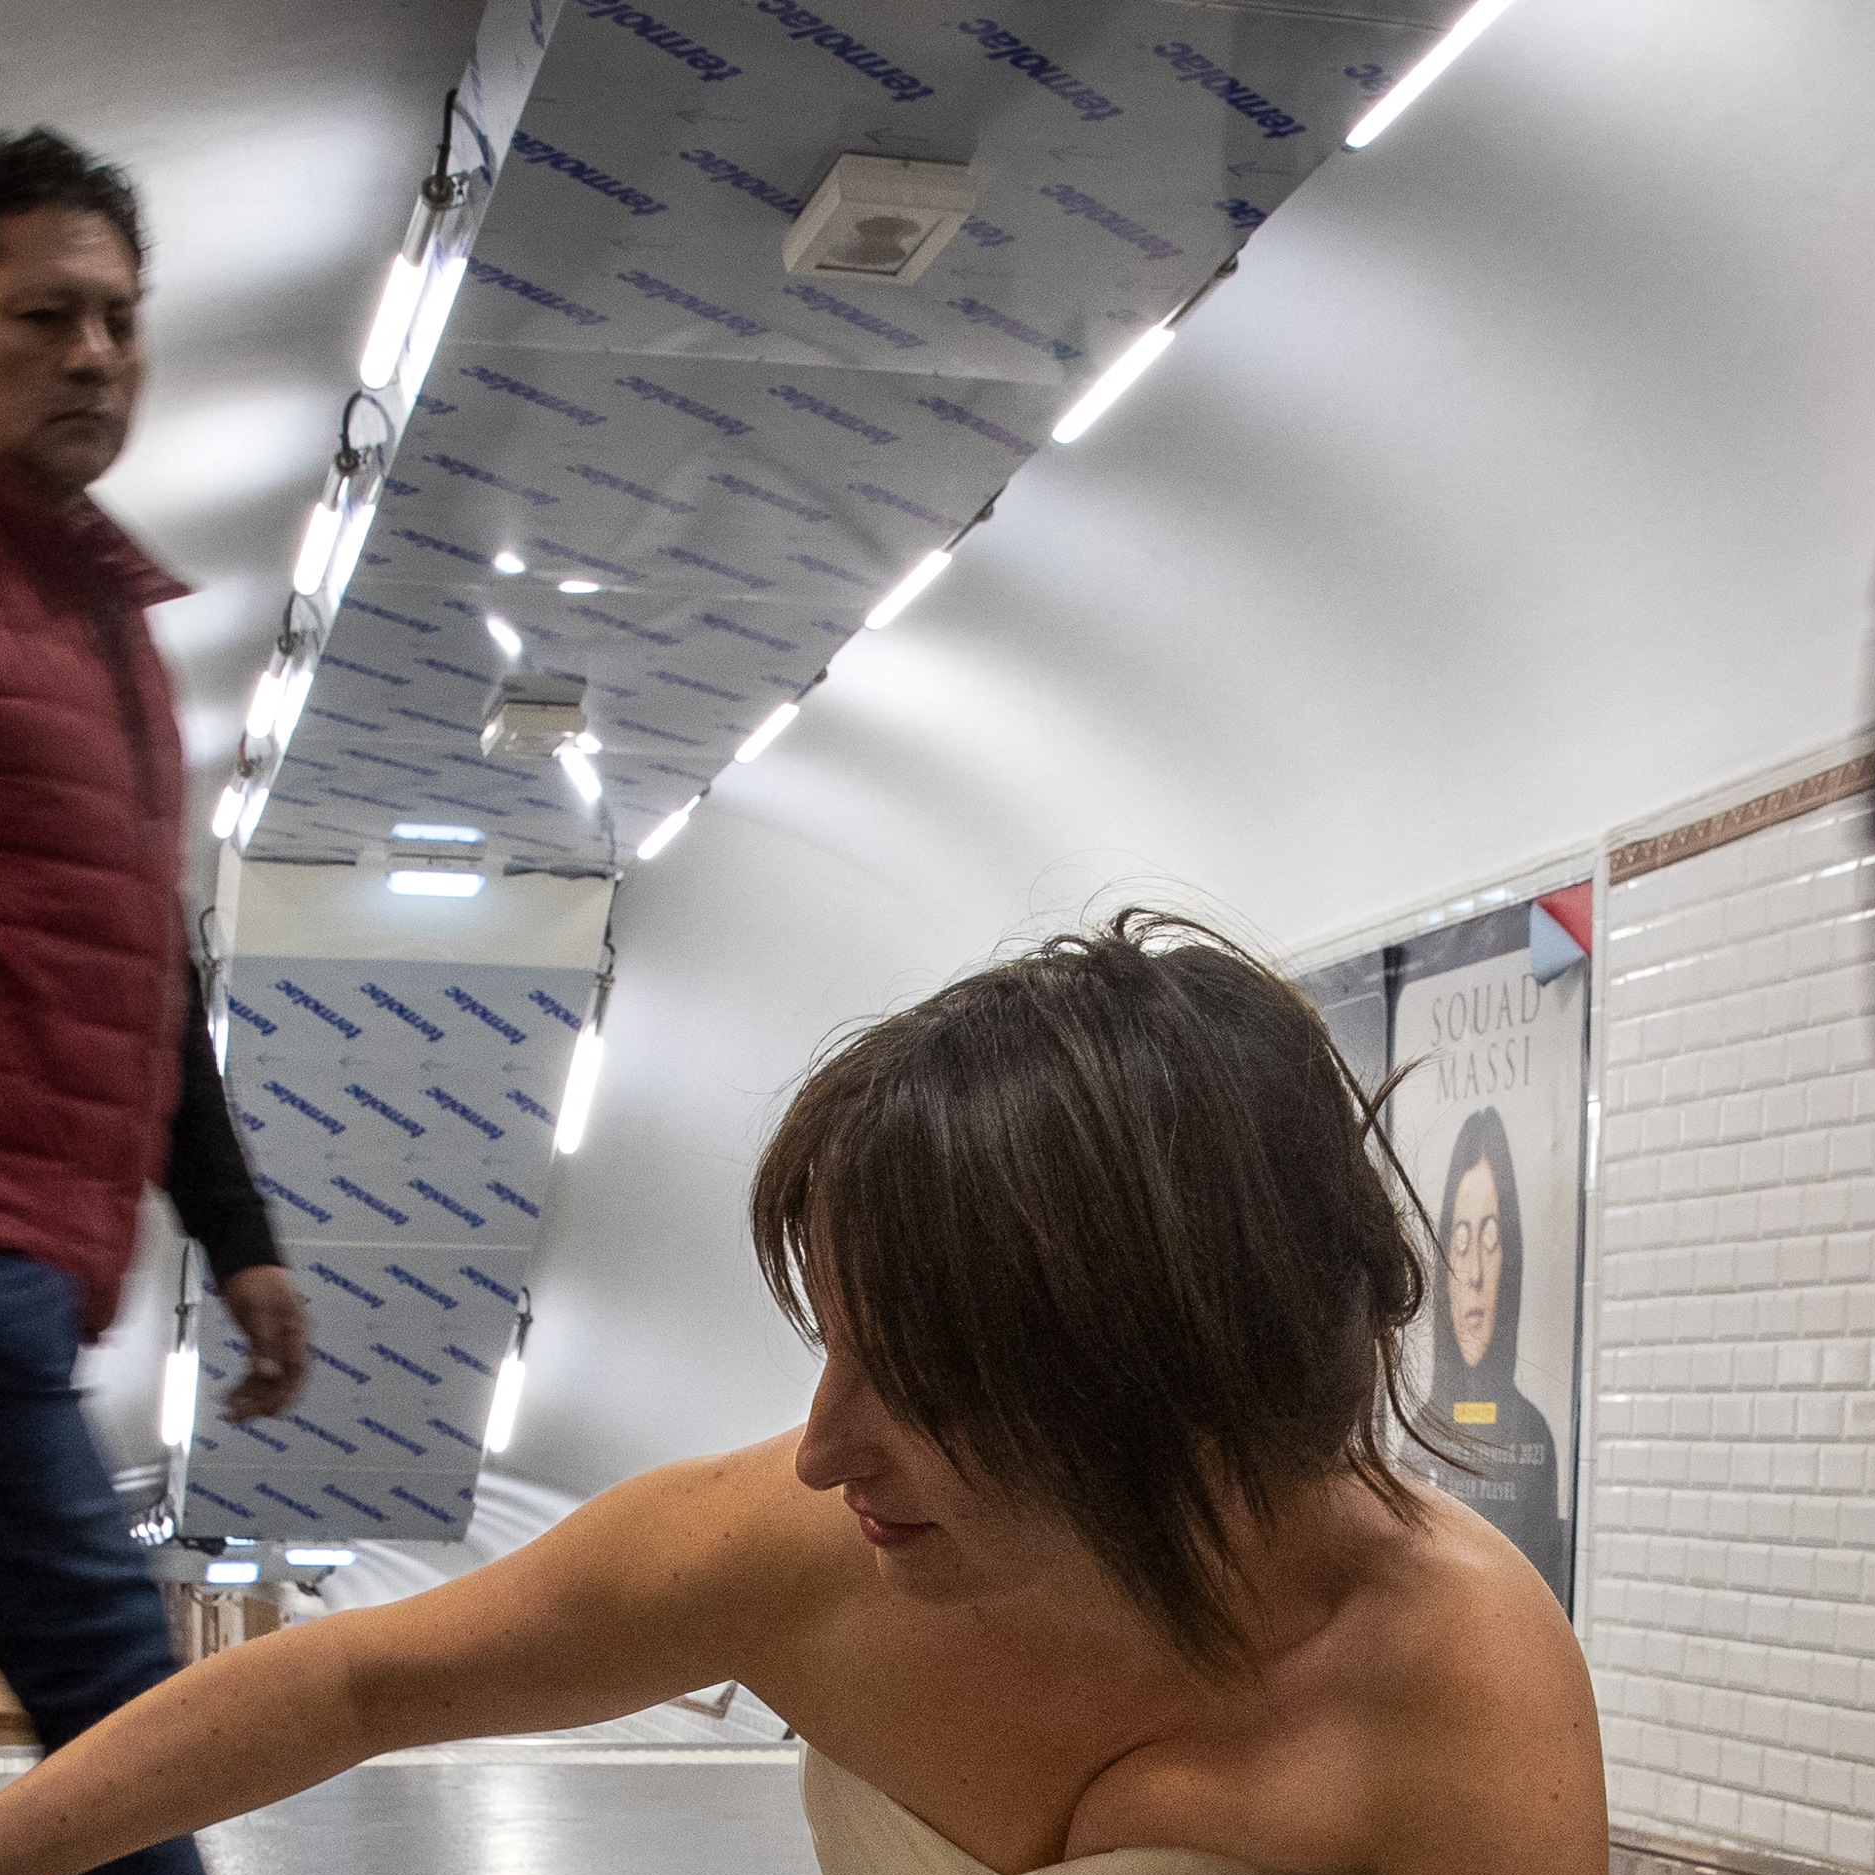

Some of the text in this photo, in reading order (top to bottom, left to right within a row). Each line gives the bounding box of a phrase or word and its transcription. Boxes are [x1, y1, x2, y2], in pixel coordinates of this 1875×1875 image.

[575, 0, 744, 83] termola
[756, 0, 935, 102] termolac
[958, 17, 1124, 122] termolac
[1153, 41, 1307, 140] termolac
[1039, 184, 1182, 259] termolac
[1431, 973, 1541, 1047] SOUAD
[1436, 1035, 1531, 1105] MASSI
